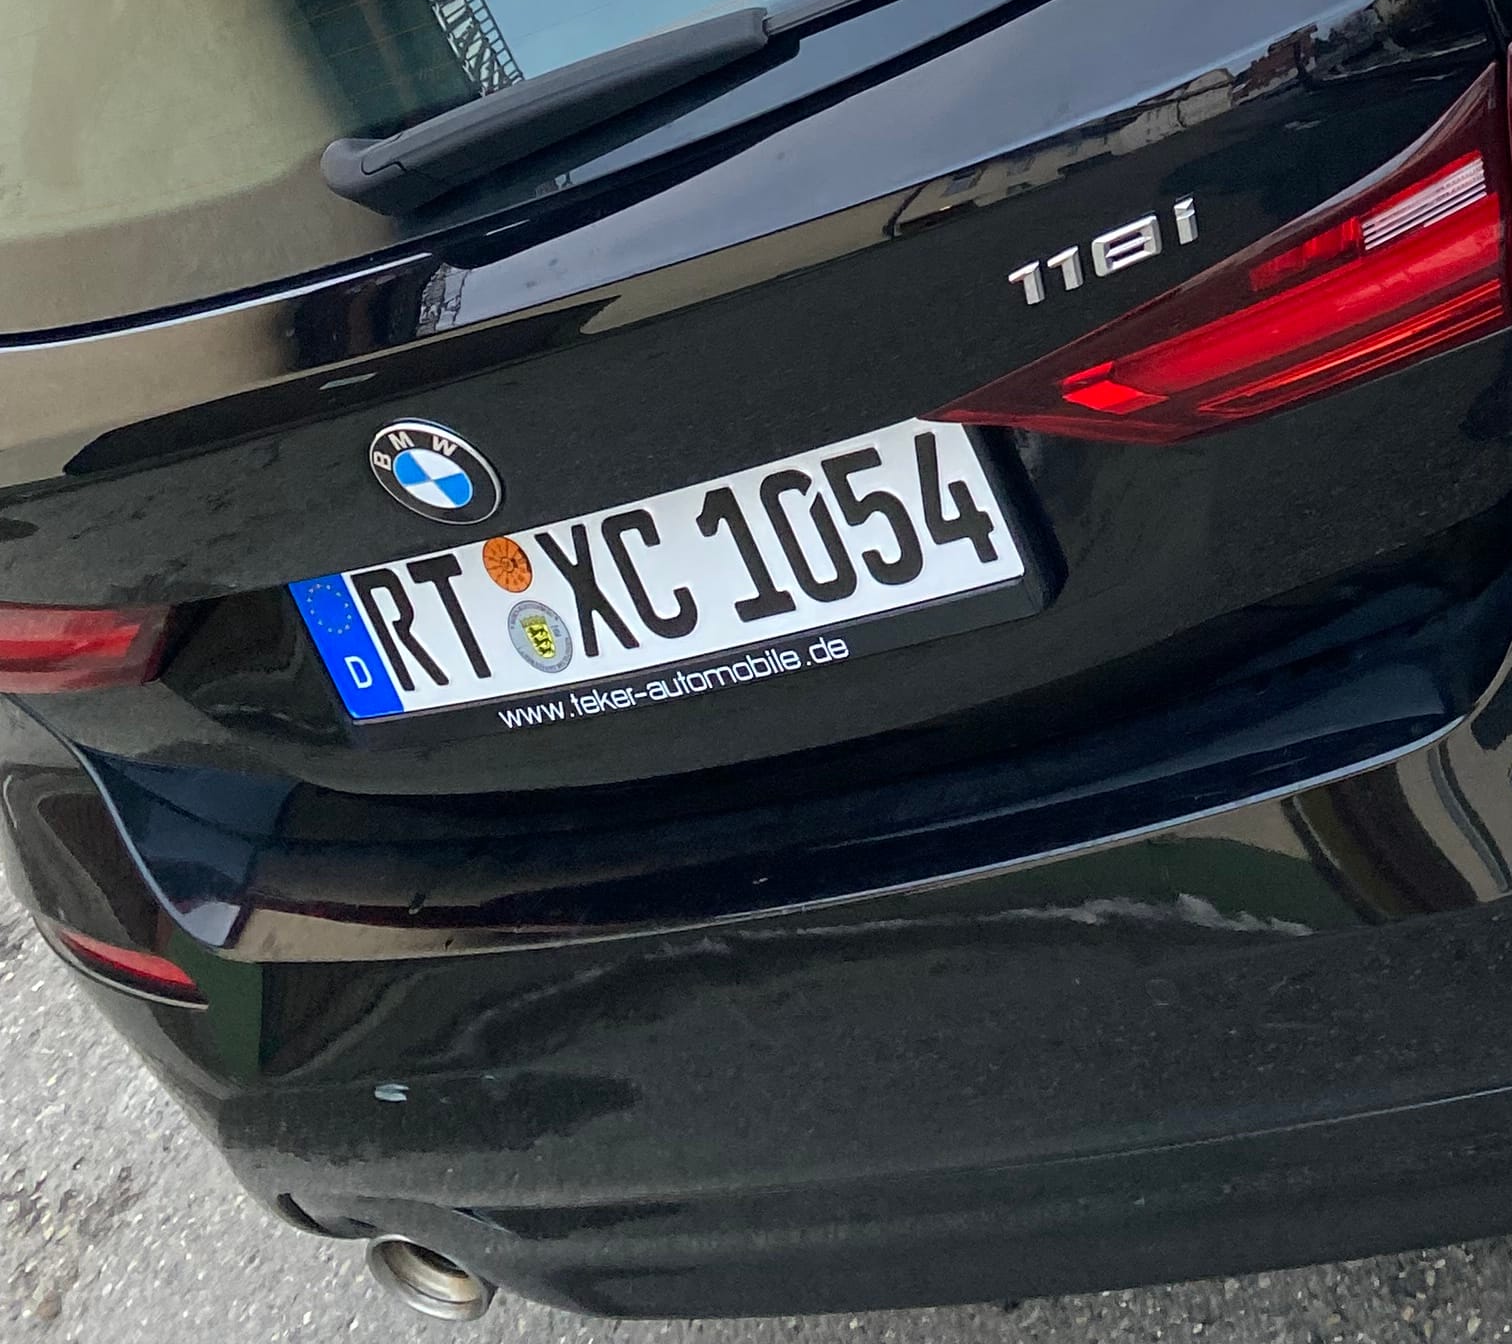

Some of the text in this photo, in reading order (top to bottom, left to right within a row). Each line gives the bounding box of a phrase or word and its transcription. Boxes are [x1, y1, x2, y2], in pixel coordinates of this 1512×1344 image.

[1008, 196, 1198, 304] 118i
[373, 431, 458, 472] BMW
[350, 553, 491, 691] RT
[534, 509, 698, 657] XC
[696, 431, 998, 622] 1054
[344, 655, 373, 689] D
[498, 636, 850, 729] www.teker-automobile.de
